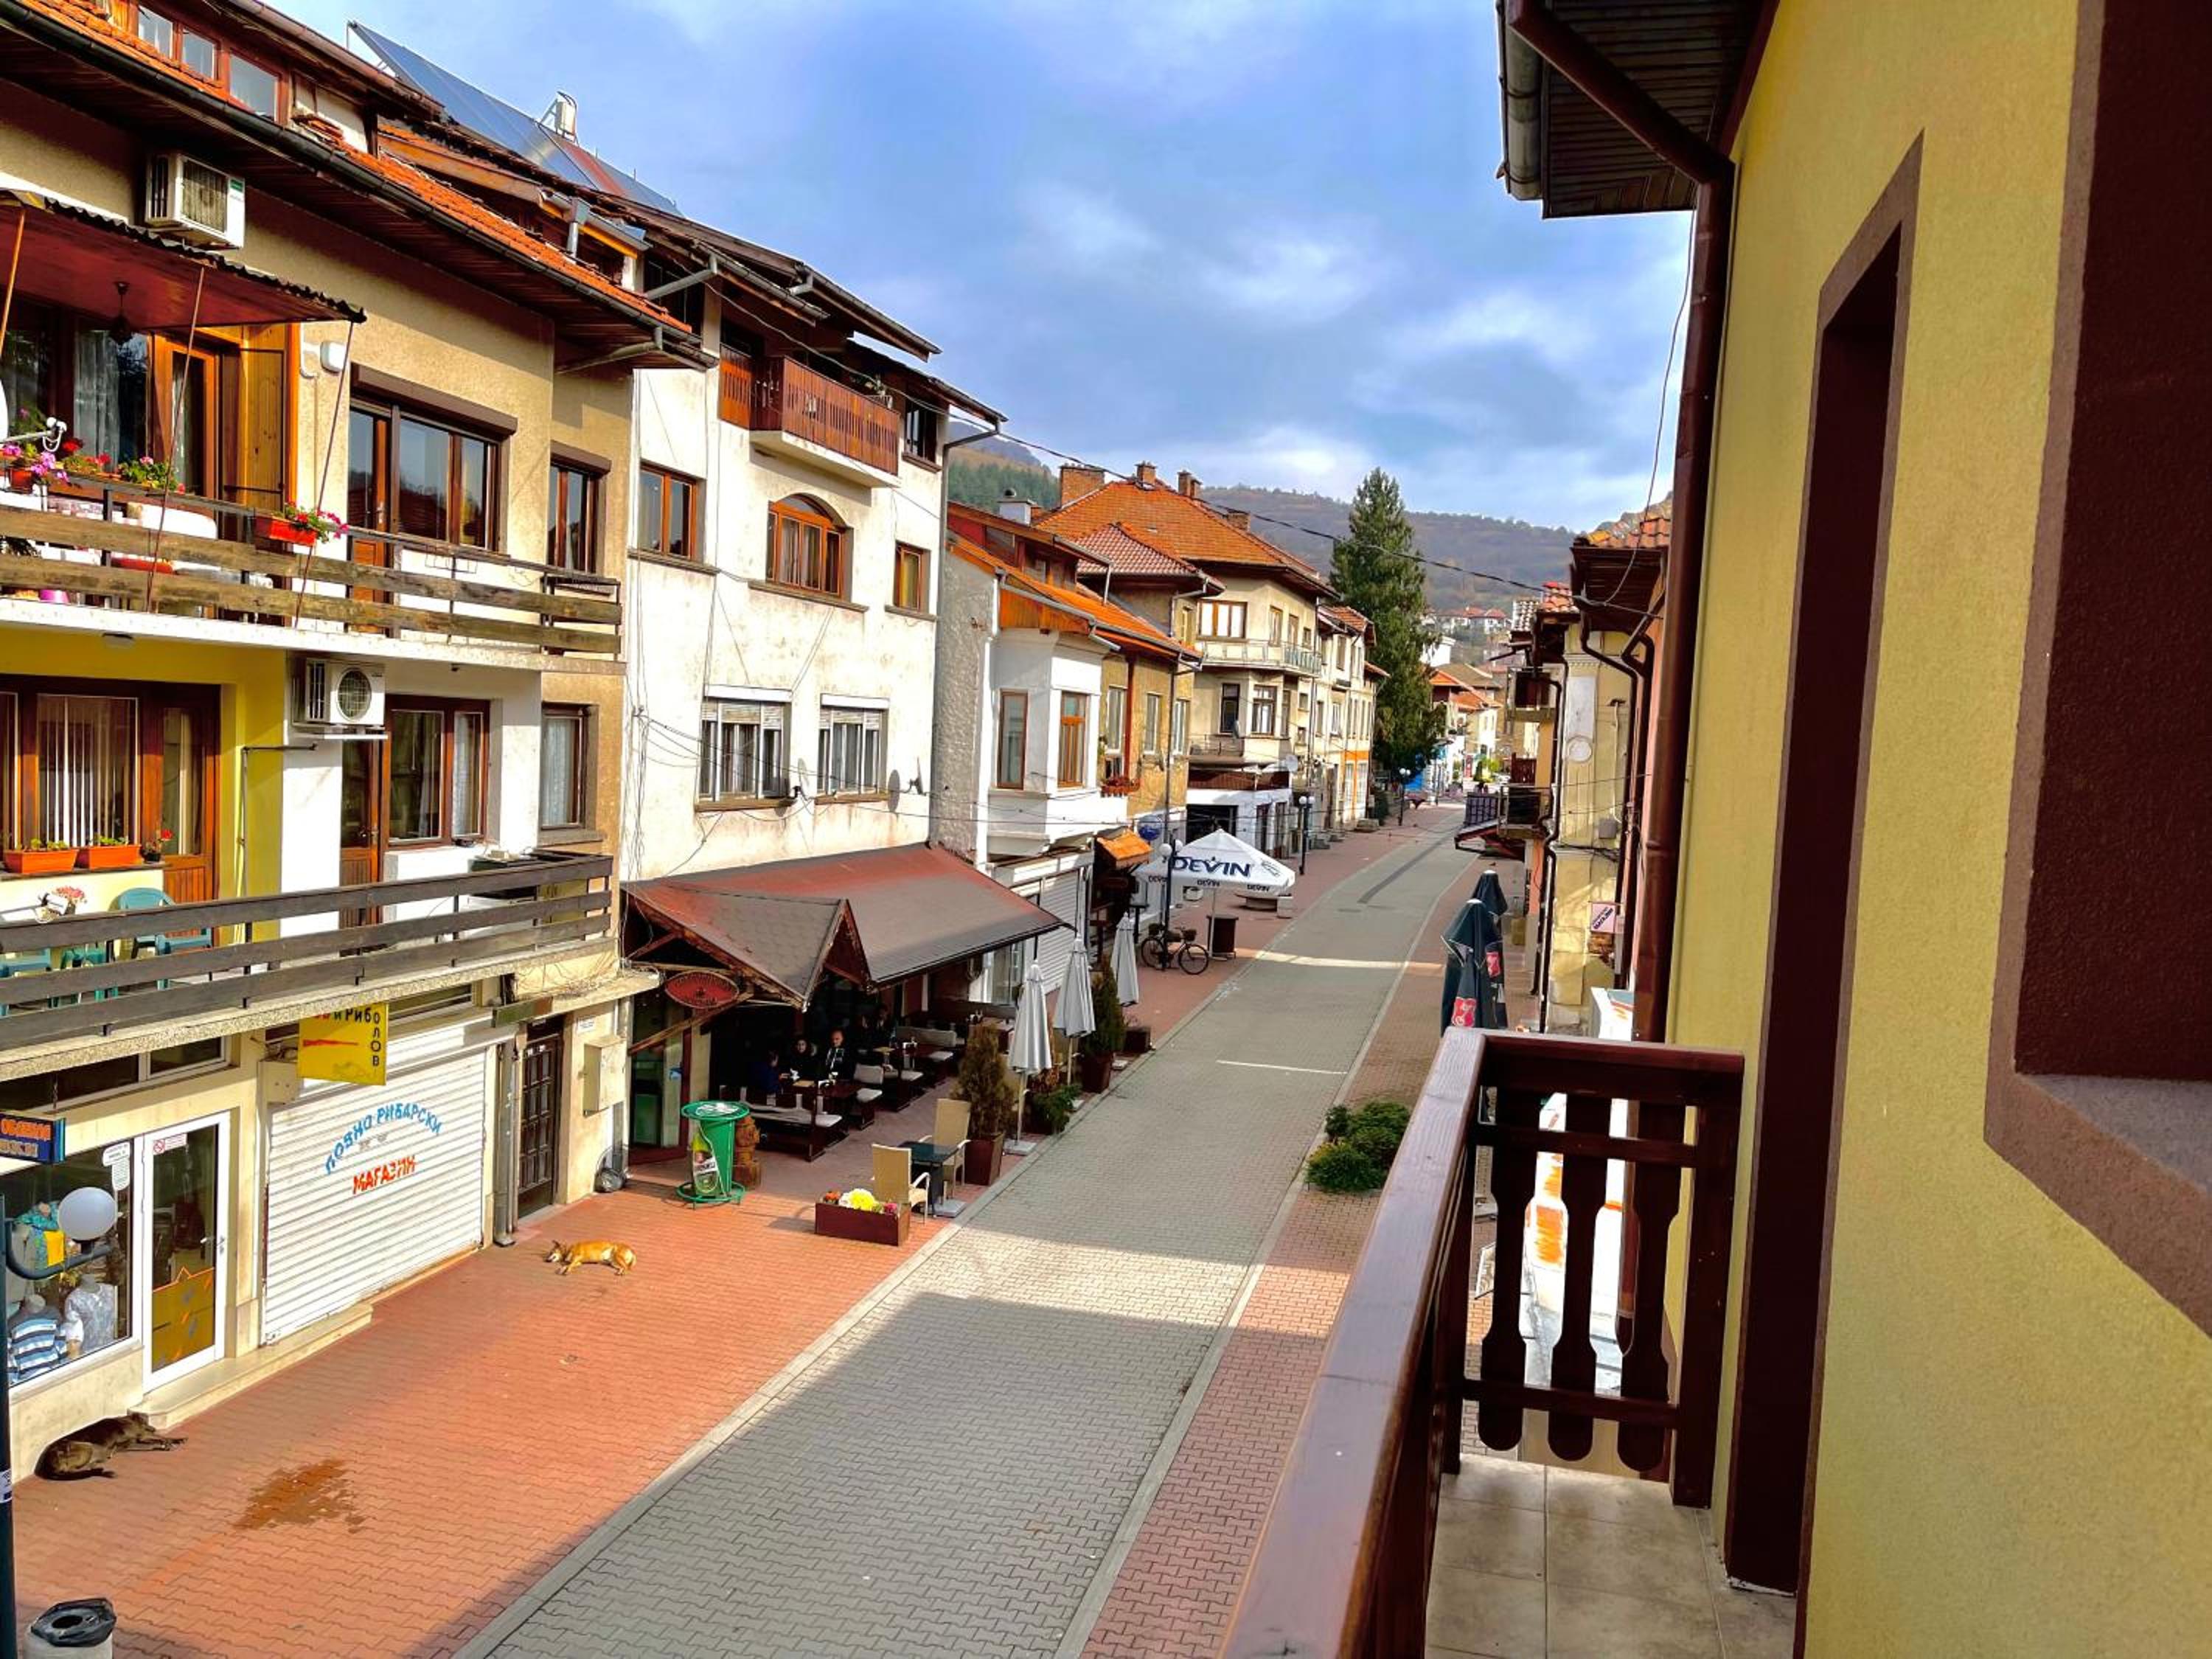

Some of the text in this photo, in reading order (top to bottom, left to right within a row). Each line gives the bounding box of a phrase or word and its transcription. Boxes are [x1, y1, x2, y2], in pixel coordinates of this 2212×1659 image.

[1172, 856, 1251, 877] DEVIN
[1197, 879, 1220, 887] DEVIN
[352, 1155, 416, 1195] МАГАЗИН
